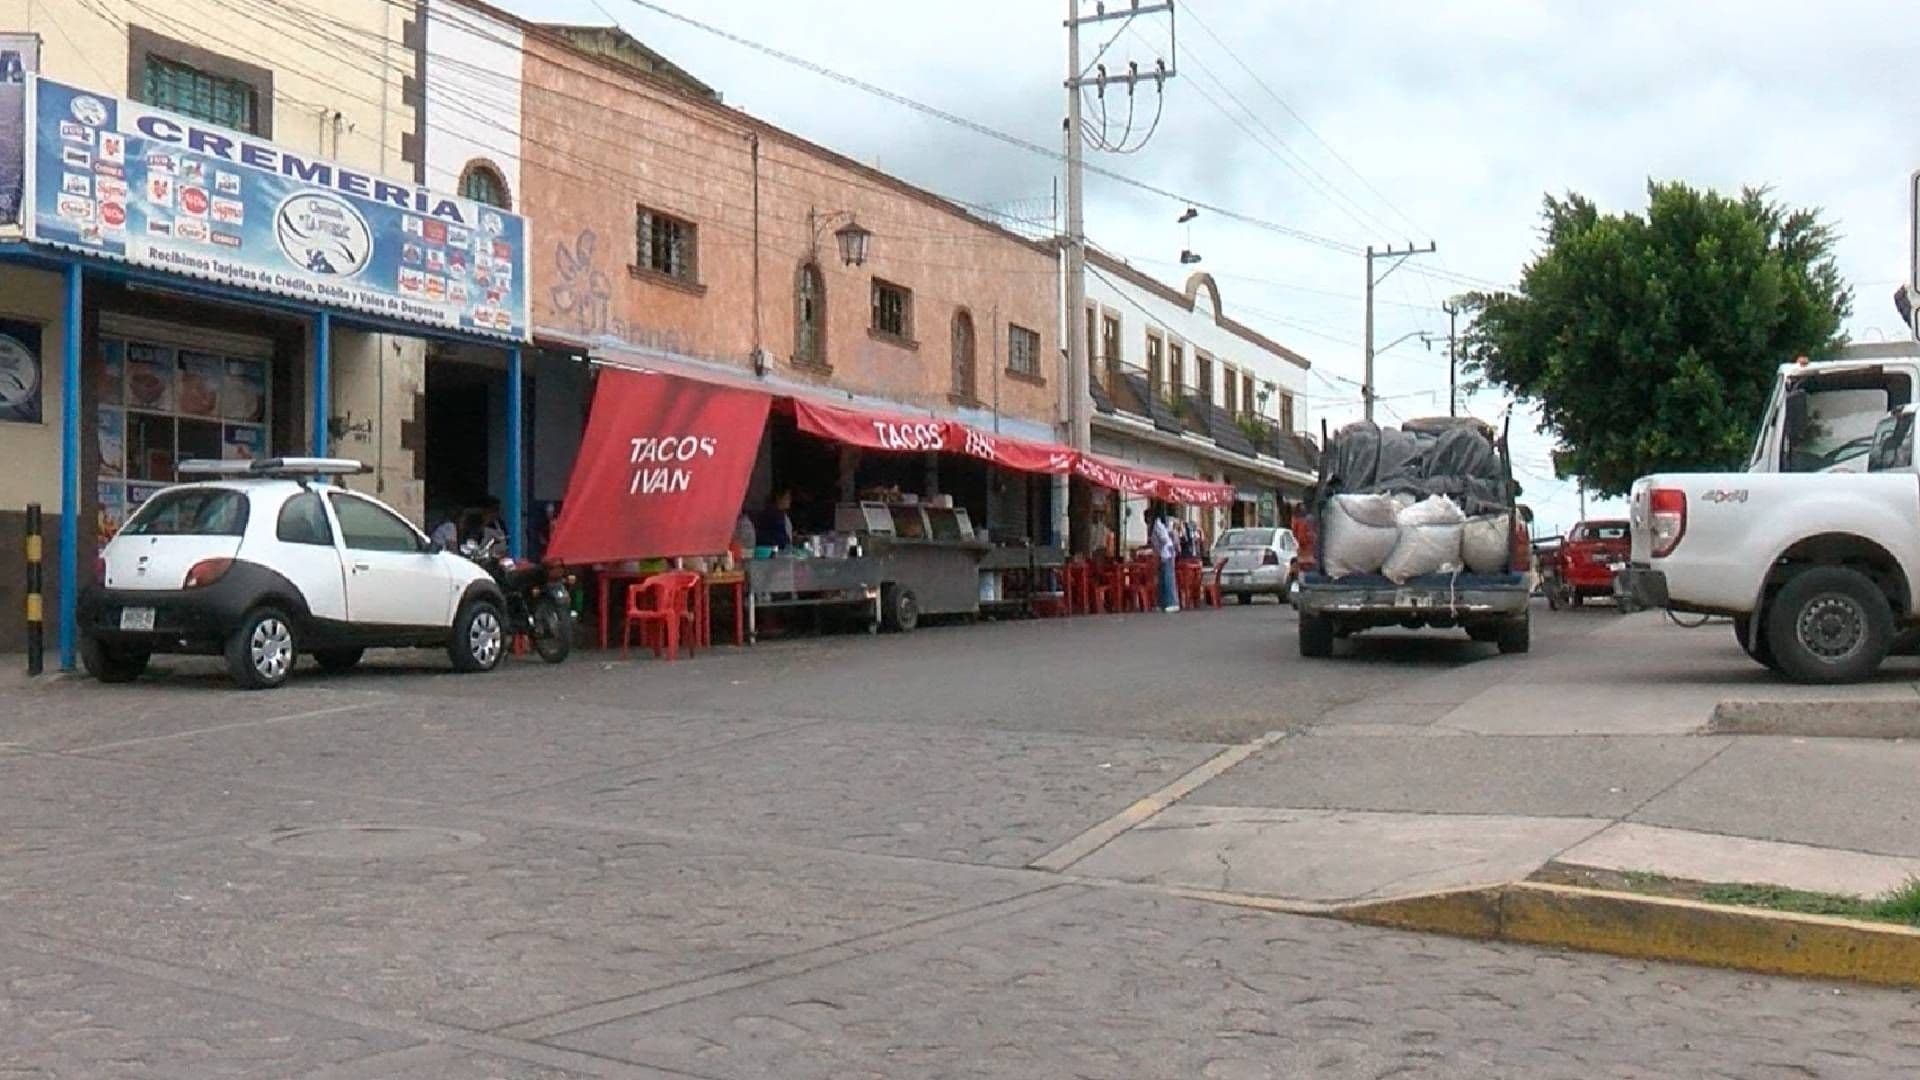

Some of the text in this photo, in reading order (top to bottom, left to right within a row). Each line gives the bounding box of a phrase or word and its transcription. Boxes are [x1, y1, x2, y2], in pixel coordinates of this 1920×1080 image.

[149, 247, 209, 269] Recibimos
[213, 259, 256, 280] Tarjetas
[258, 271, 272, 284] de
[387, 298, 398, 309] de
[401, 300, 444, 320] Despensa
[630, 435, 718, 462] TACOS
[872, 421, 944, 449] TACOS
[630, 467, 693, 494] IVAN
